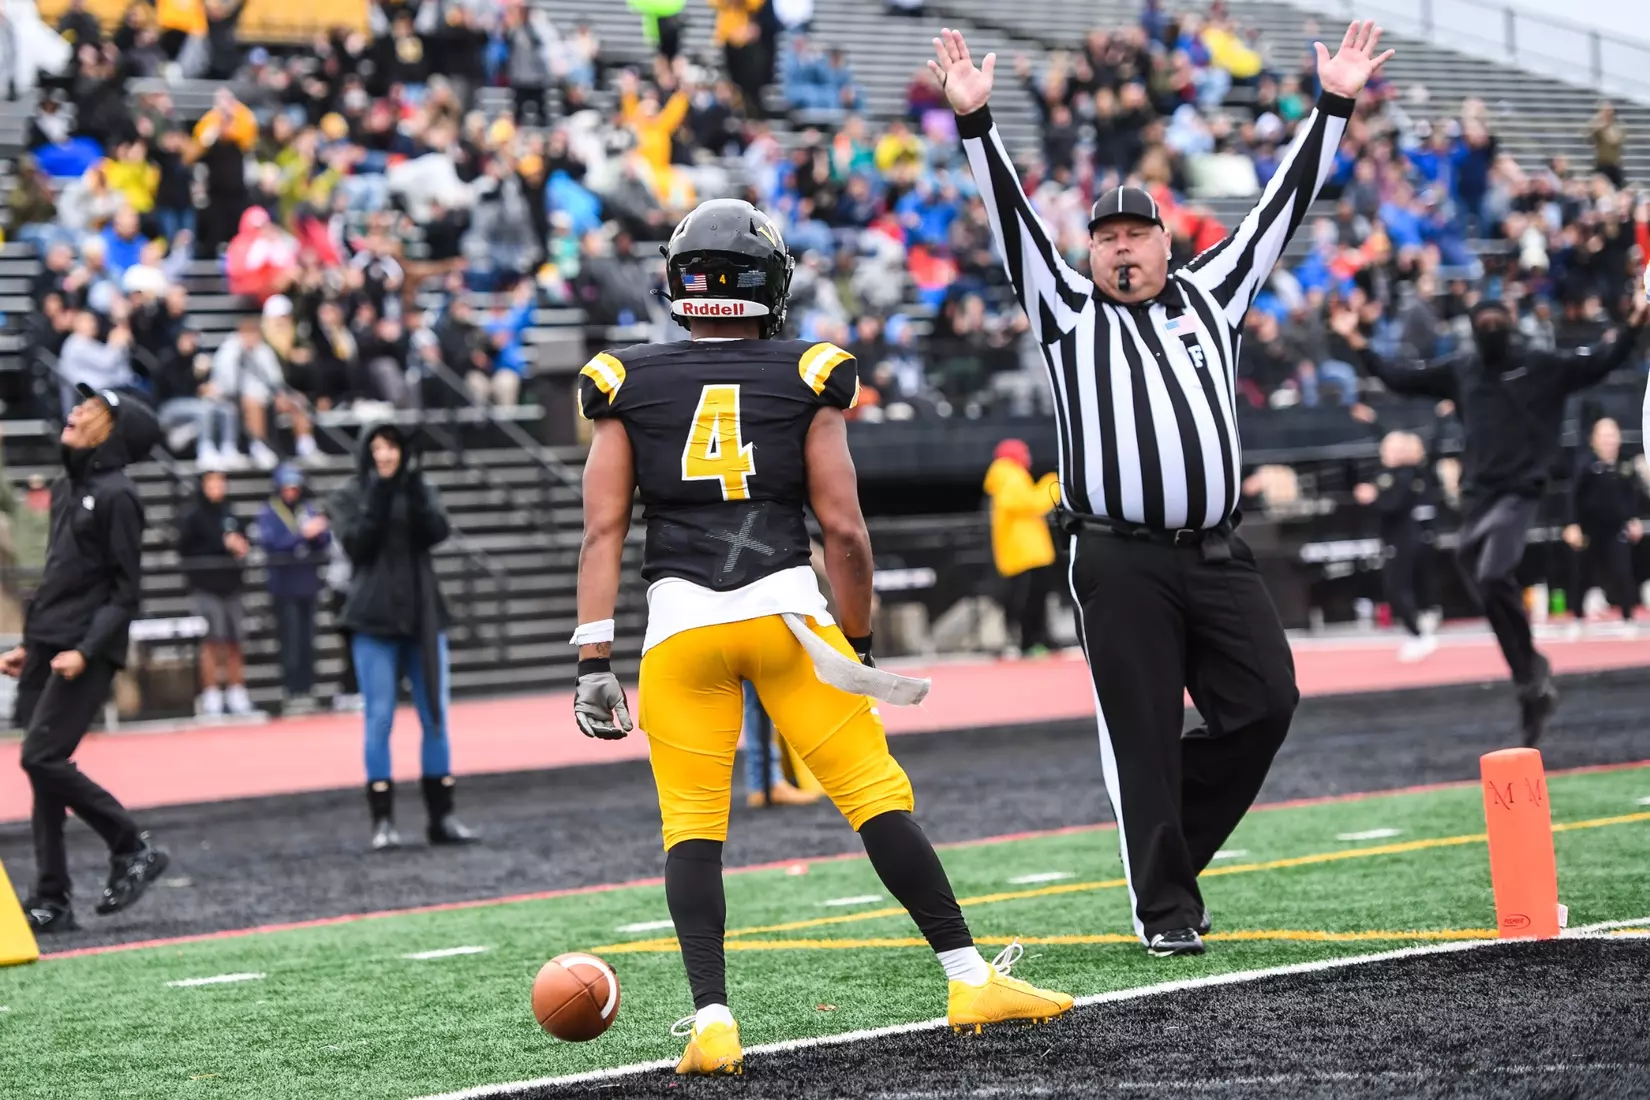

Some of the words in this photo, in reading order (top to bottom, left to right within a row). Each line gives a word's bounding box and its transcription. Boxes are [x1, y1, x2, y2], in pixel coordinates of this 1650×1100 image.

[719, 274, 726, 284] 4
[683, 303, 744, 315] Riddell
[1187, 344, 1204, 368] F
[681, 384, 756, 501] 4
